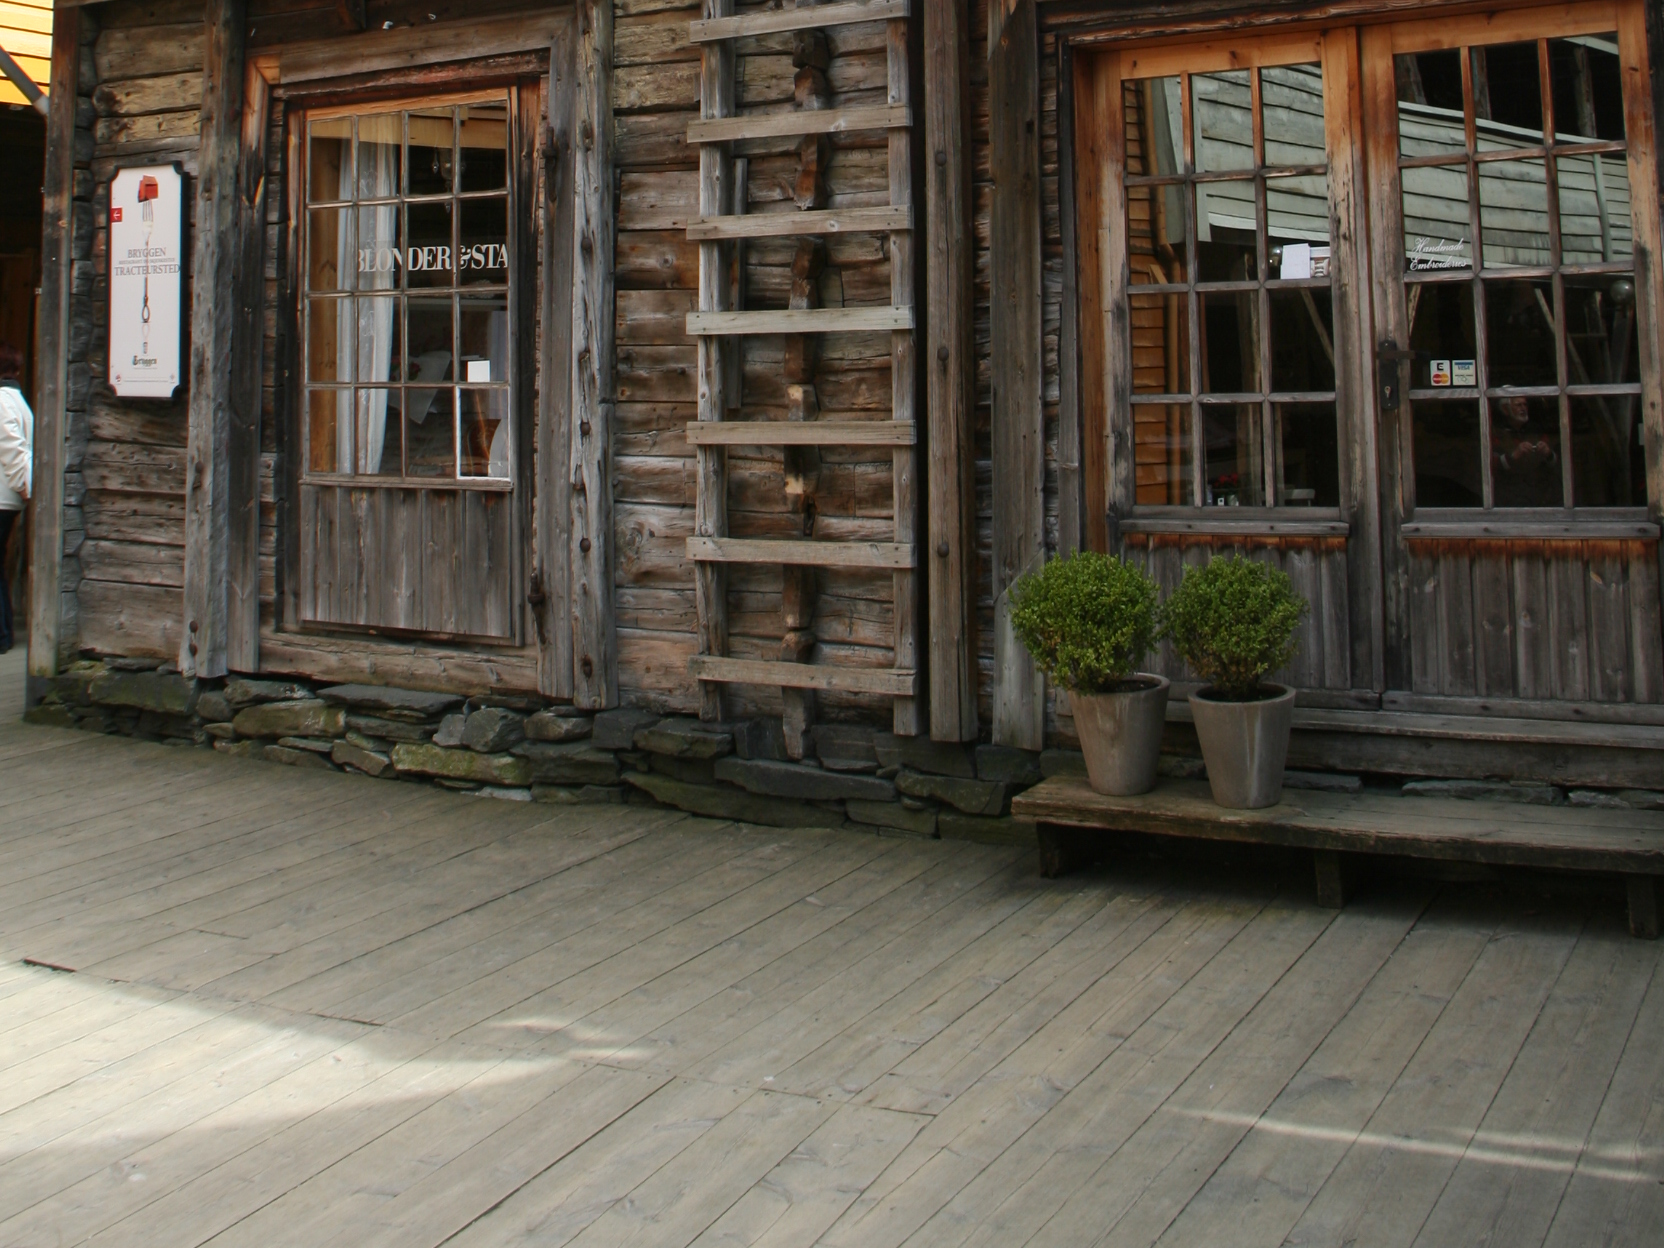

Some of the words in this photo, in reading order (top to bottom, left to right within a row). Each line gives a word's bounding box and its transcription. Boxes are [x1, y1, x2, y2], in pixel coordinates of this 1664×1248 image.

[1412, 237, 1464, 253] Handmade
[127, 247, 166, 259] BRYGGEN
[114, 263, 181, 276] TRACTEURSTED
